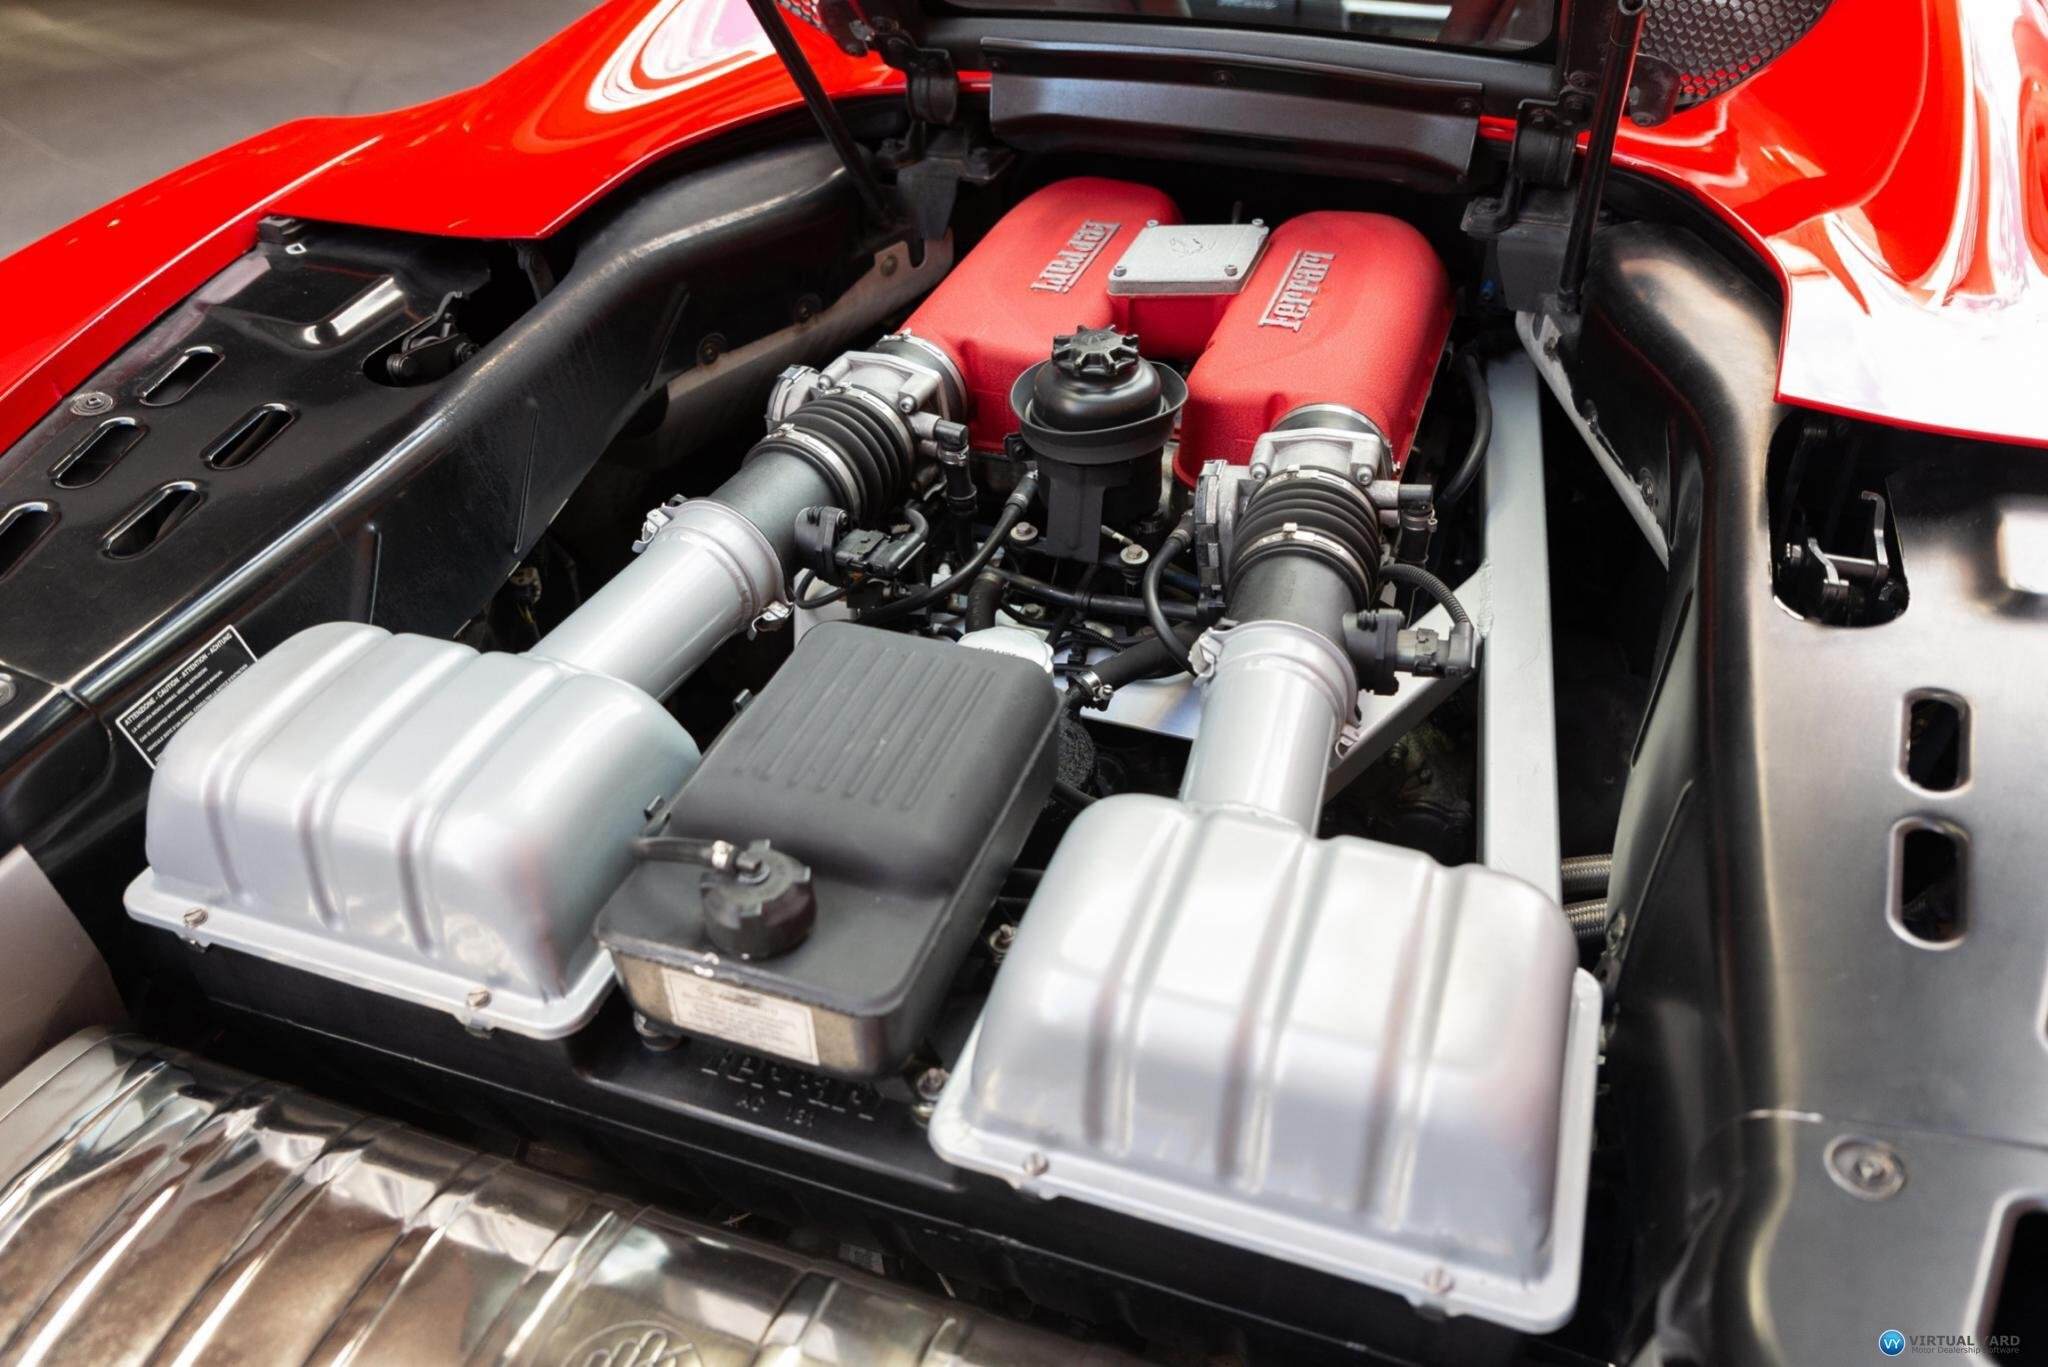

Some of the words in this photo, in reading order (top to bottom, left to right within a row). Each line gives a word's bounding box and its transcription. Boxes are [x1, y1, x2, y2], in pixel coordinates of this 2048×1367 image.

[1030, 219, 1120, 293] Ferrari
[1259, 249, 1336, 332] Ferrari
[124, 697, 155, 725] ATTENZIONE
[157, 677, 180, 698] CAUTION
[181, 653, 208, 677] ATTENTION
[209, 632, 232, 653] ACHTUNG
